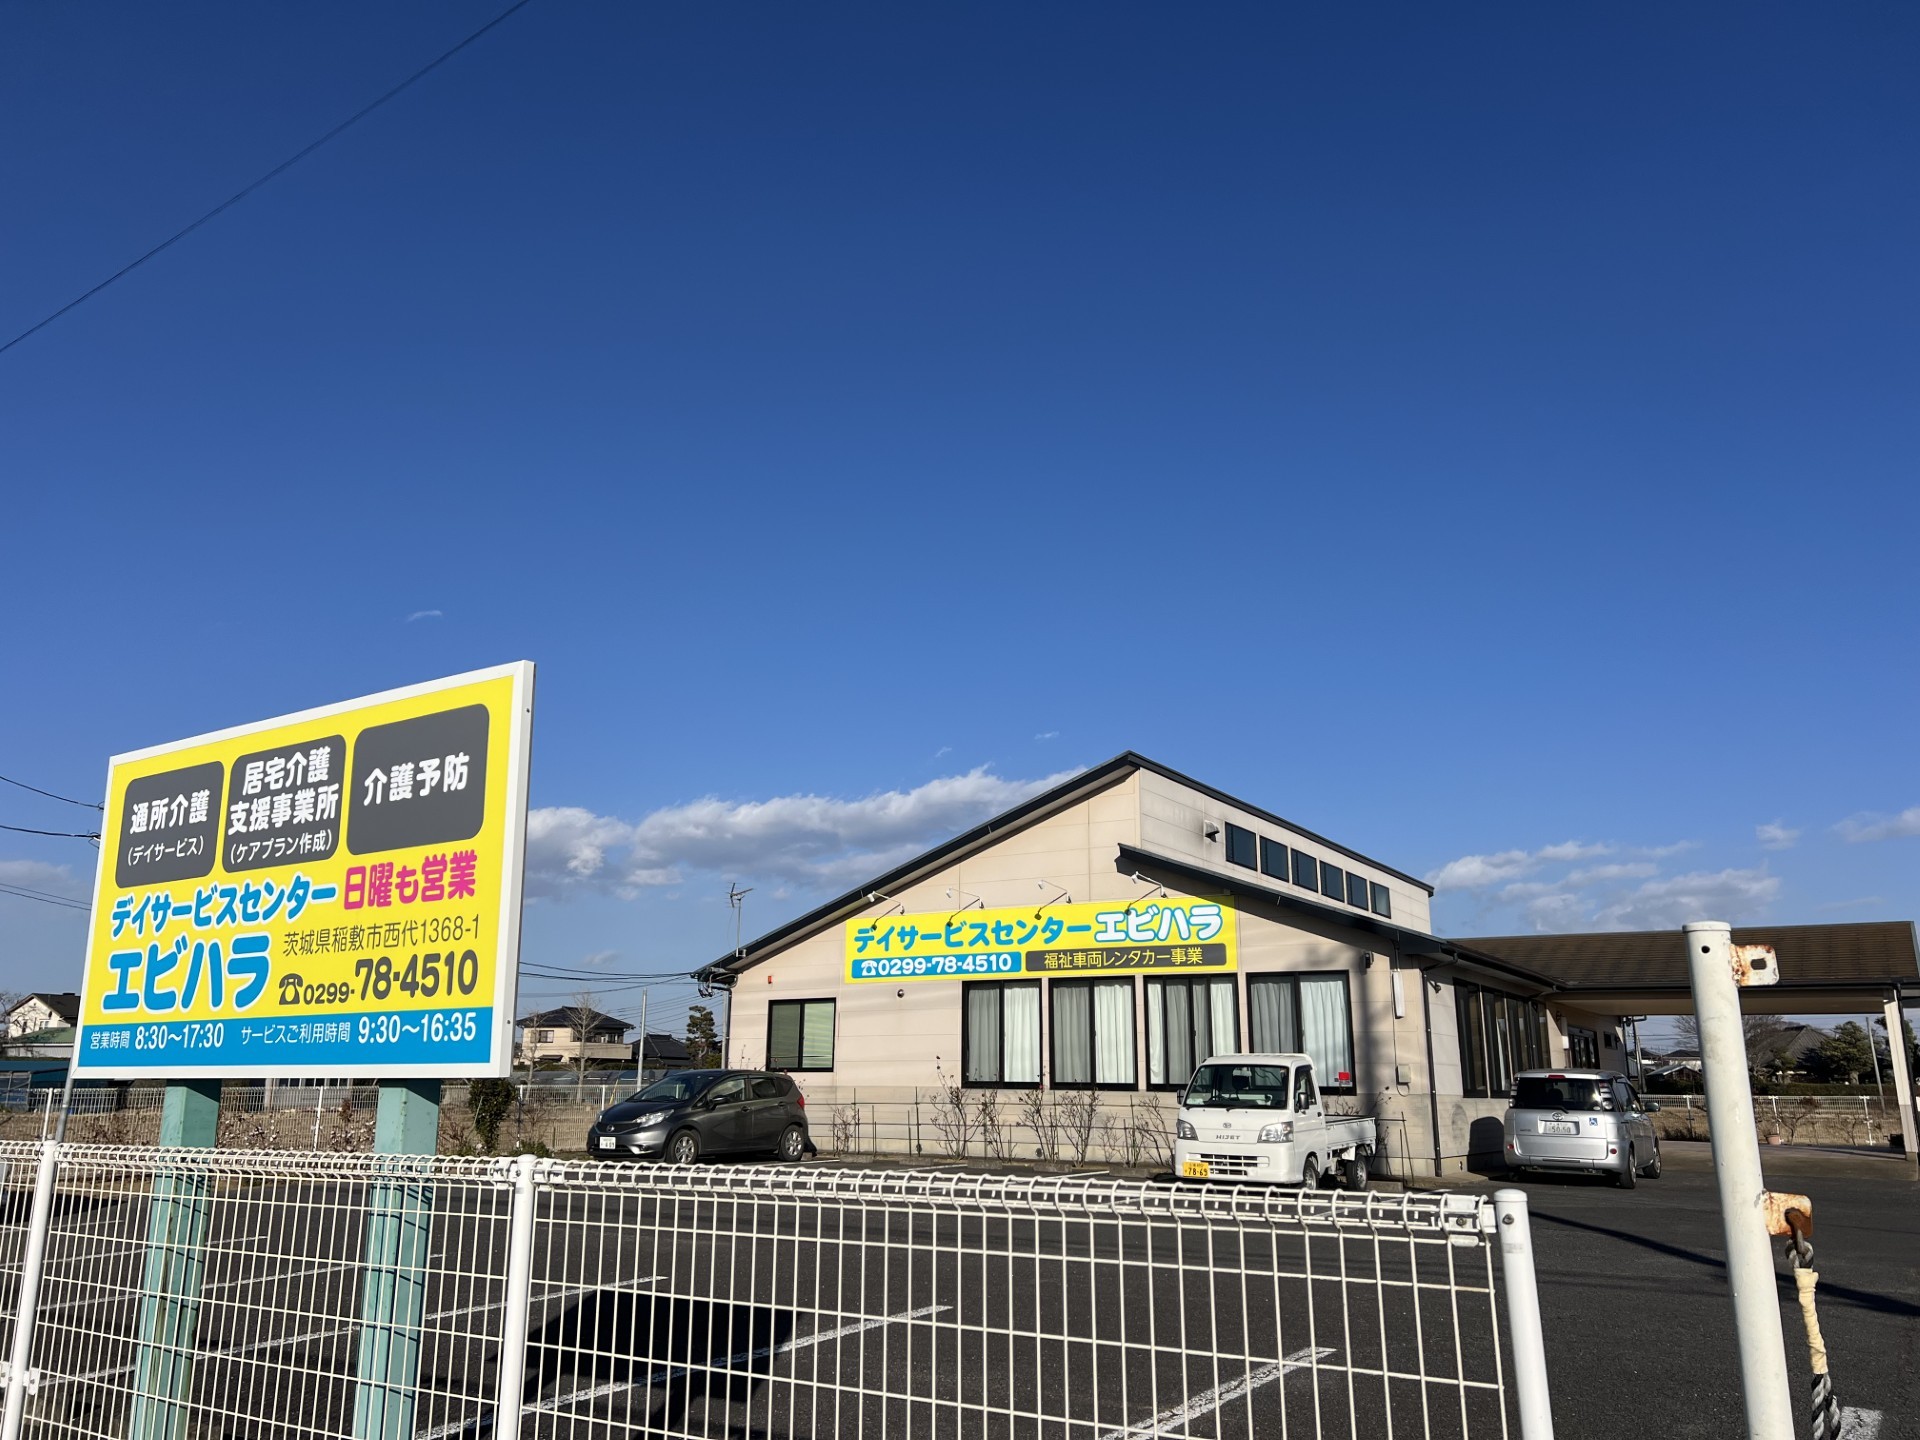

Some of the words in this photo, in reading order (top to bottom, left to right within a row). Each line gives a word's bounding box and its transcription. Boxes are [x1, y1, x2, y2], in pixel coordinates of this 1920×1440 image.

[242, 746, 331, 796] 居宅介護
[363, 752, 470, 807] 介護予防
[129, 789, 210, 834] 通所介護
[227, 783, 339, 836] 支援事業所
[343, 849, 478, 910] 日曜も営業
[111, 872, 337, 938] デイサービスセンター
[853, 914, 1092, 953] デイサービスセンター
[1094, 903, 1224, 943] エビハラ
[282, 914, 480, 957] 茨城県稲敷市西代1368-1
[1043, 947, 1203, 969] 福祉車両レンタカー事業
[100, 933, 271, 1013] エビハラ
[877, 954, 1012, 976] 0299-78-4510
[90, 1030, 130, 1050] 営業時間
[241, 1021, 350, 1045] サービスご利用時間
